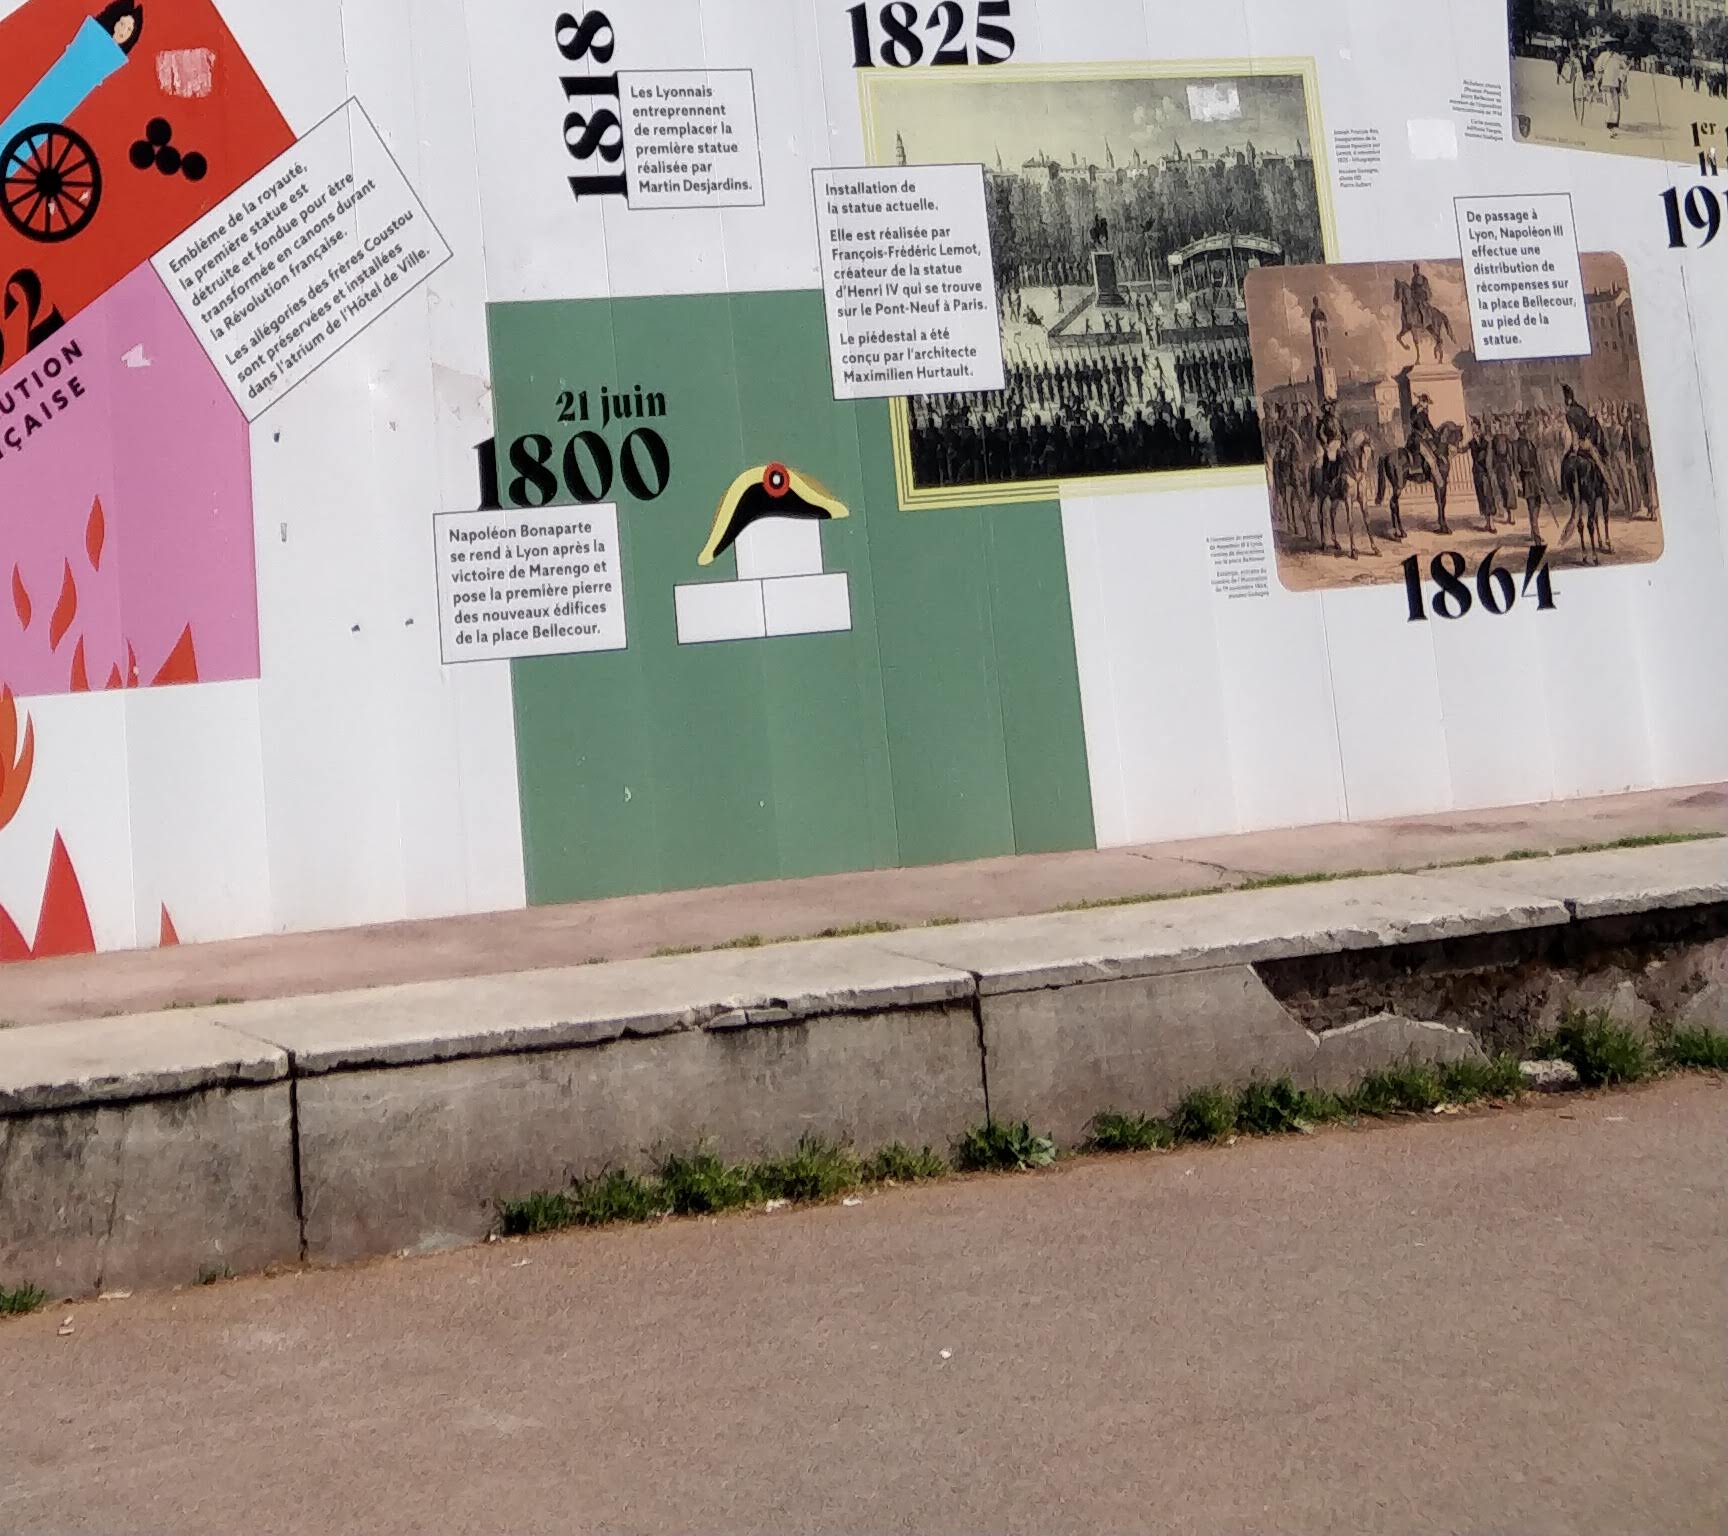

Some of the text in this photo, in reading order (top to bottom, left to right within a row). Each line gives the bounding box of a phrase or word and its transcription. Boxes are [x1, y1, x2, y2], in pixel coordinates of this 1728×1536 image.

[630, 84, 712, 101] Les Lyonnais
[555, 9, 628, 203] 1818
[632, 99, 726, 120] entreprennent
[633, 120, 732, 139] de remplacer la
[635, 140, 738, 159] première statue
[637, 159, 712, 176] réalisée par
[638, 176, 752, 195] Martin Desjardins.
[825, 179, 915, 196] Installation de
[826, 197, 938, 214] la statue actuelle.
[1466, 207, 1538, 225] De passage à
[168, 161, 307, 273] Emblème de la royauté,
[1658, 185, 1728, 250] 19
[178, 183, 309, 291] la première statue est
[191, 172, 354, 307] détruite et fondue pour être
[829, 224, 950, 242] Elle est réalisée par
[1468, 224, 1563, 243] Lyon, Napoléon III
[200, 178, 375, 323] transformée en canons durant
[831, 242, 981, 263] François-Frédéric Lemot,
[1471, 243, 1540, 257] effectue une
[833, 261, 962, 279] créateur de la statue
[1473, 259, 1555, 275] distribution de
[209, 230, 347, 341] la Révolution française.
[835, 280, 982, 298] d'Henri IV qui se trouve
[1475, 279, 1568, 294] récompenses sur
[837, 297, 987, 319] sur le Pont-Neuf à Paris.
[1477, 294, 1576, 312] la place Bellecour,
[554, 384, 667, 429] 21 juin
[472, 427, 671, 512] 1800
[448, 521, 591, 545] Napoléon Bonaparte
[449, 538, 605, 562] se rend à Lyon après la
[450, 560, 607, 583] victoire de Marengo et
[1400, 544, 1561, 622] 1864
[452, 580, 612, 608] pose la première pierre
[454, 599, 606, 624] des nouveaux édifices
[455, 622, 600, 646] de la place Bellecour.
